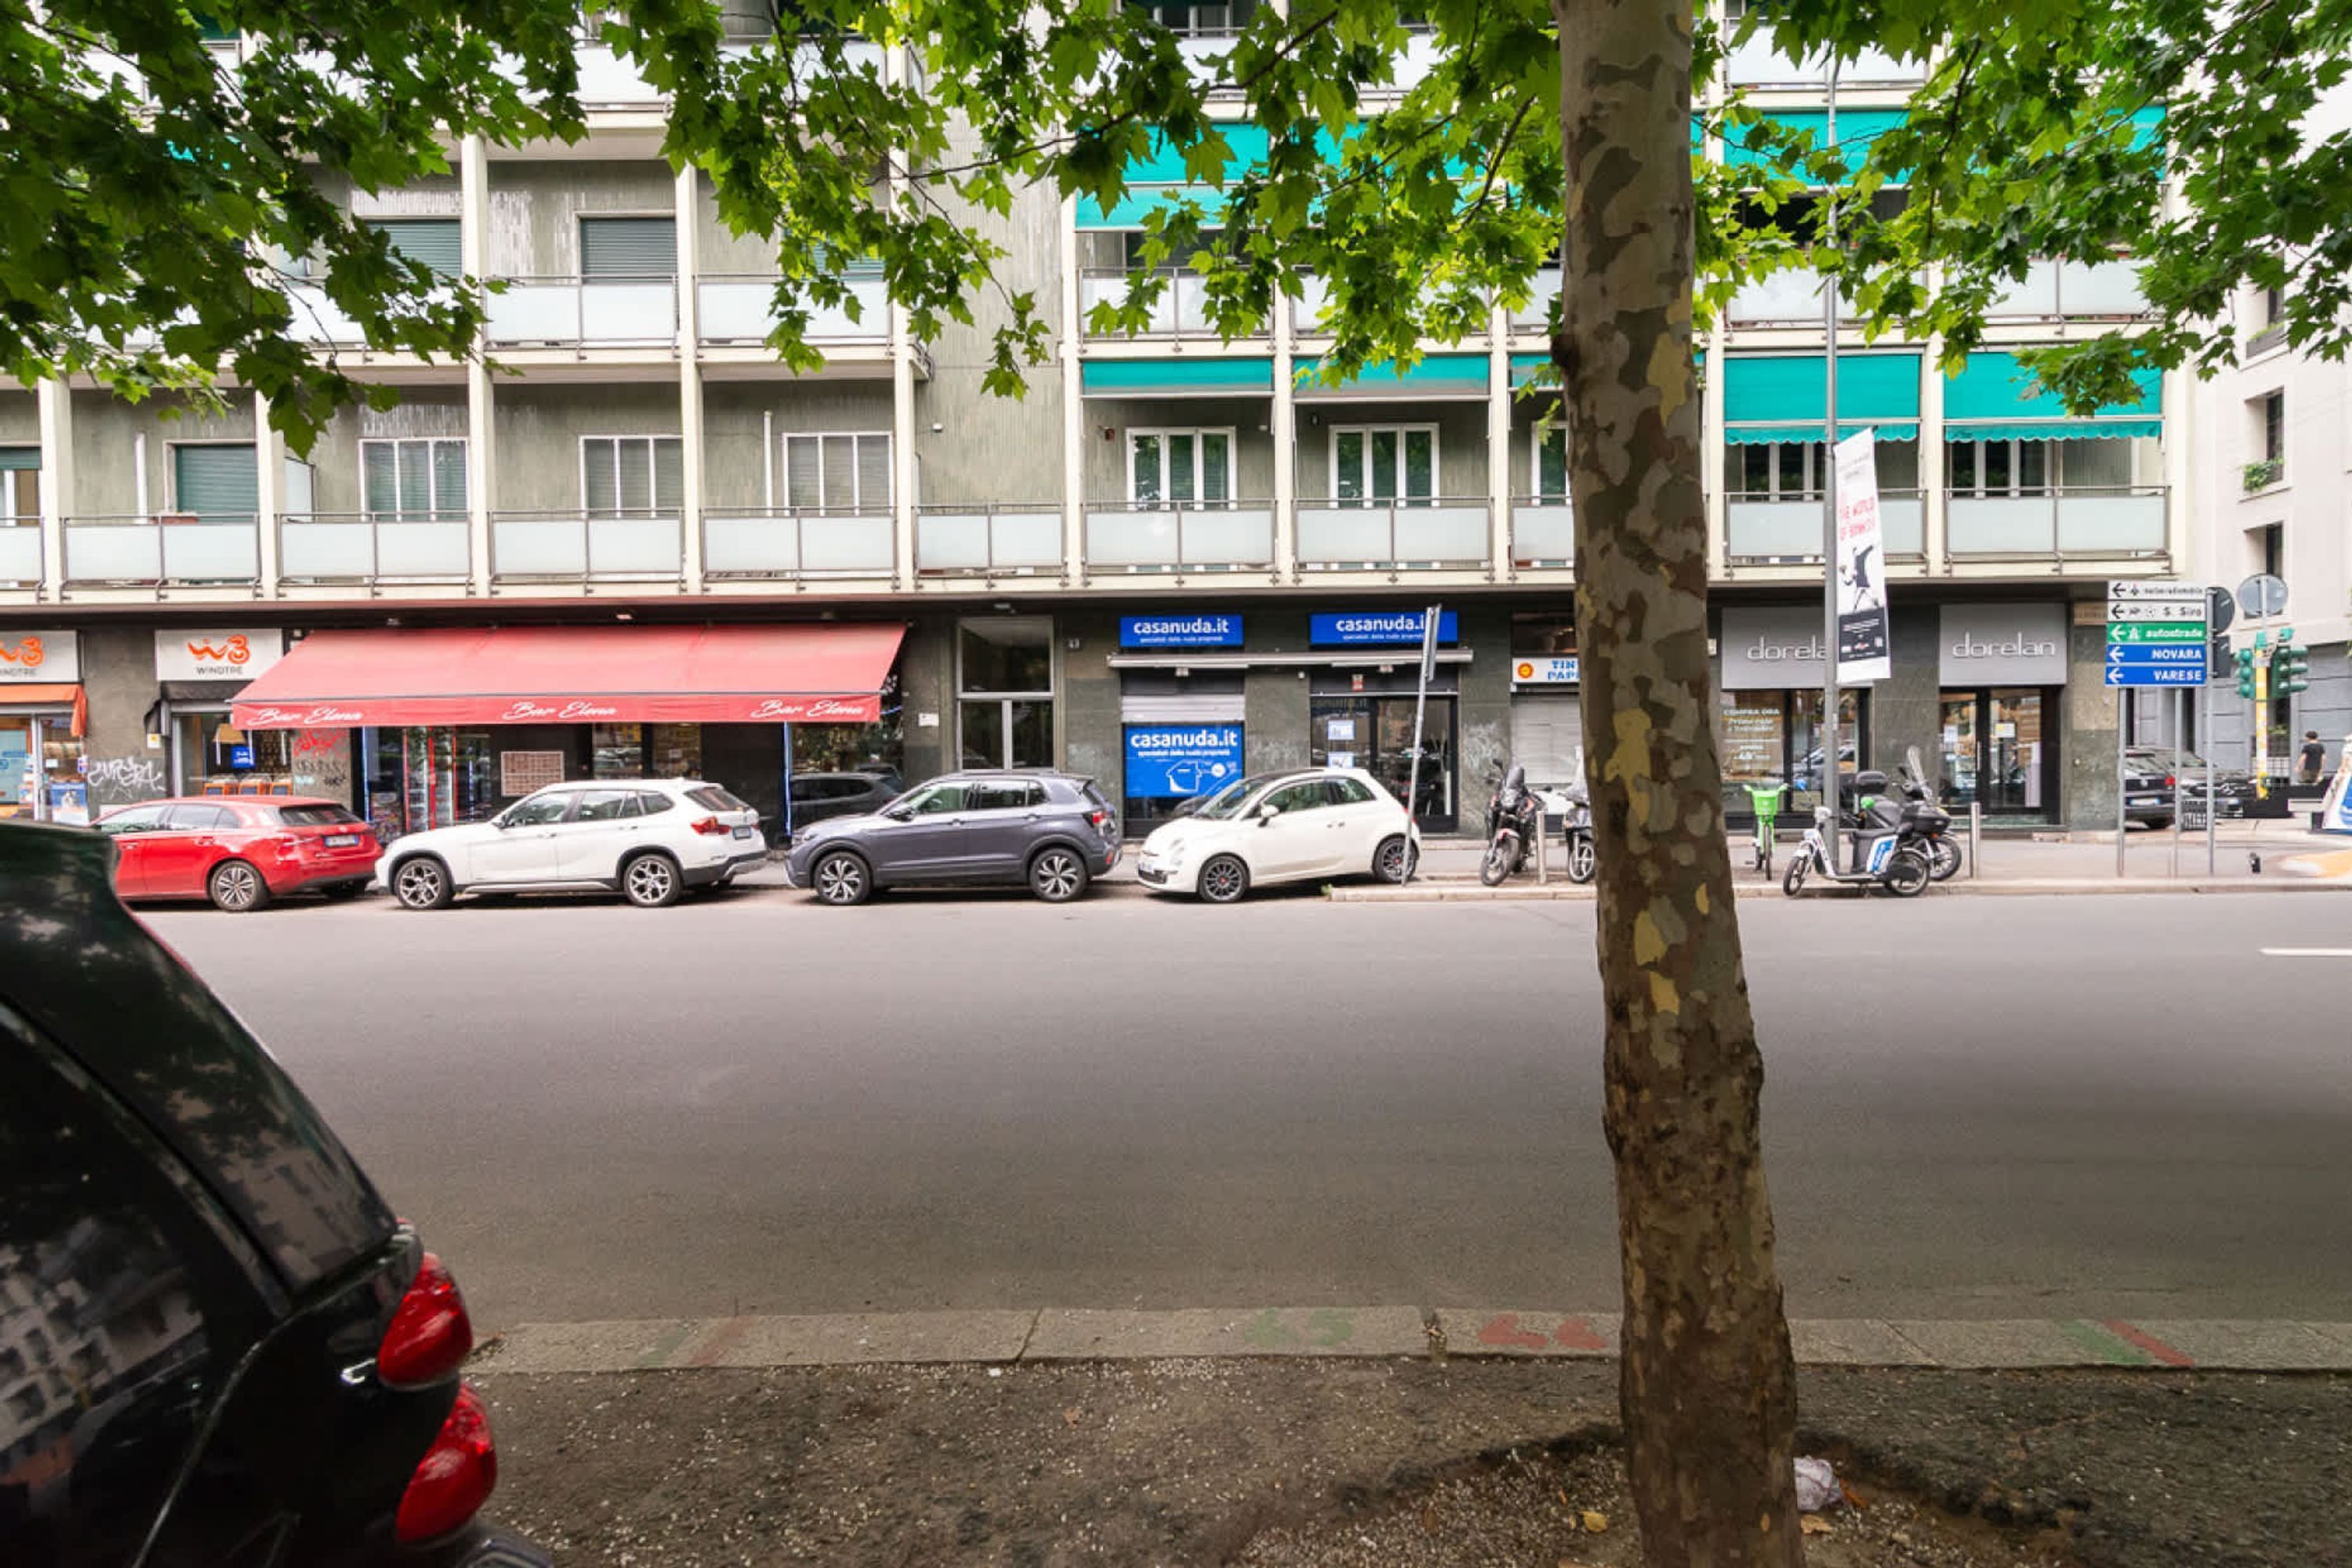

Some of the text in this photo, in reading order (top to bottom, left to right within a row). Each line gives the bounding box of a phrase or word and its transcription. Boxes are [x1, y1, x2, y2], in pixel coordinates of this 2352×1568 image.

[1134, 618, 1229, 634] casanuda.it
[1335, 615, 1425, 632] casanuda.i
[1953, 633, 2055, 658] dorelan
[2151, 648, 2201, 659] NOVARA
[2154, 670, 2202, 681] VARESE
[247, 706, 363, 726] Bar Elena
[502, 701, 617, 720] Bar Elena
[750, 699, 863, 718] Bar Elena
[1131, 729, 1237, 748] casanuda.it
